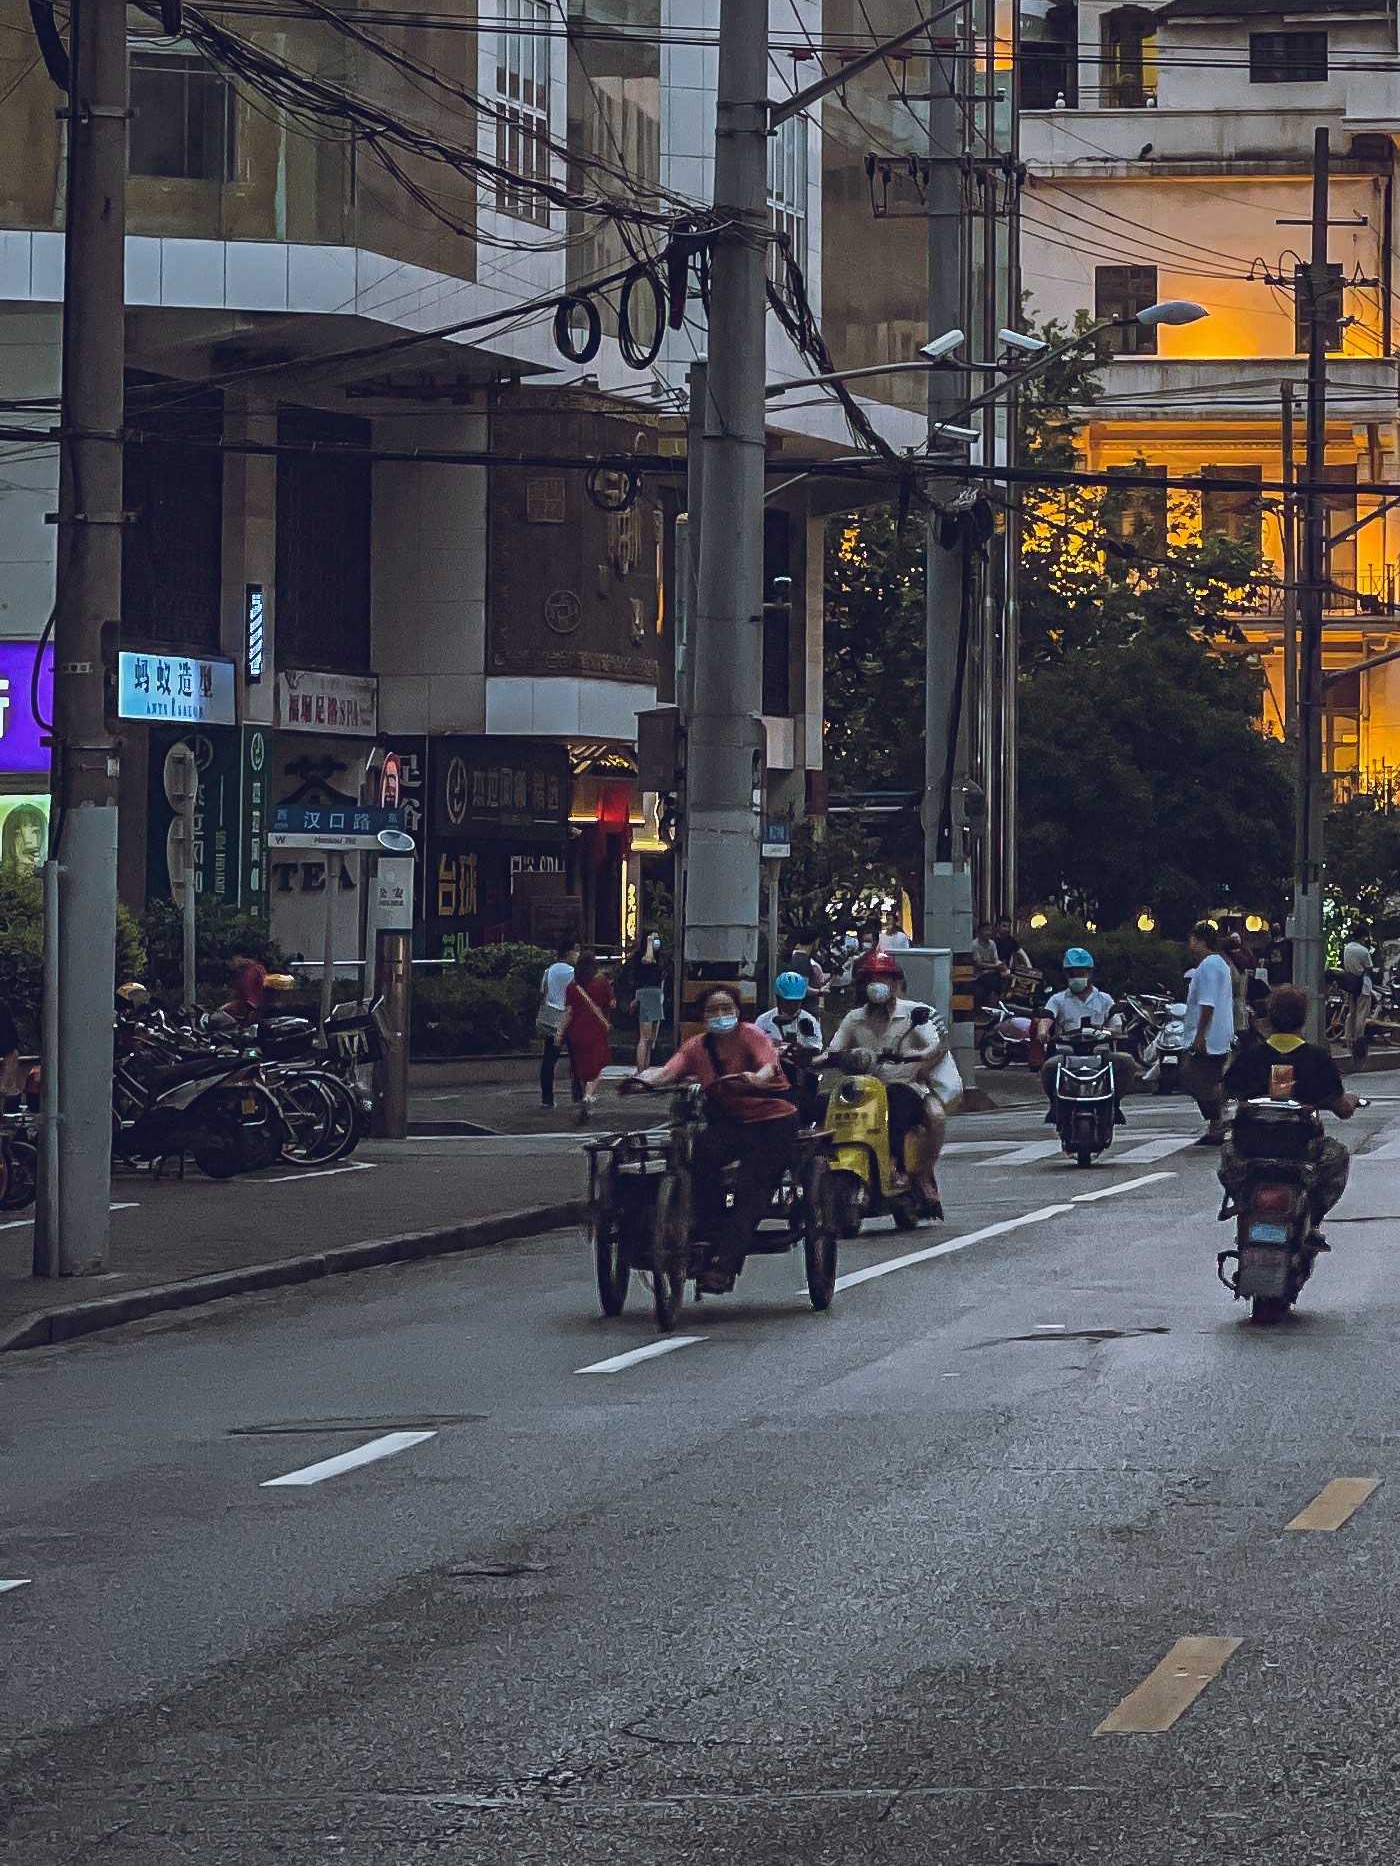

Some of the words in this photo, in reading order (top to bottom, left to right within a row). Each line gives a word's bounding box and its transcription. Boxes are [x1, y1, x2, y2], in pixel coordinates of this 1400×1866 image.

[304, 810, 370, 831] 汉口路
[274, 836, 286, 845] W
